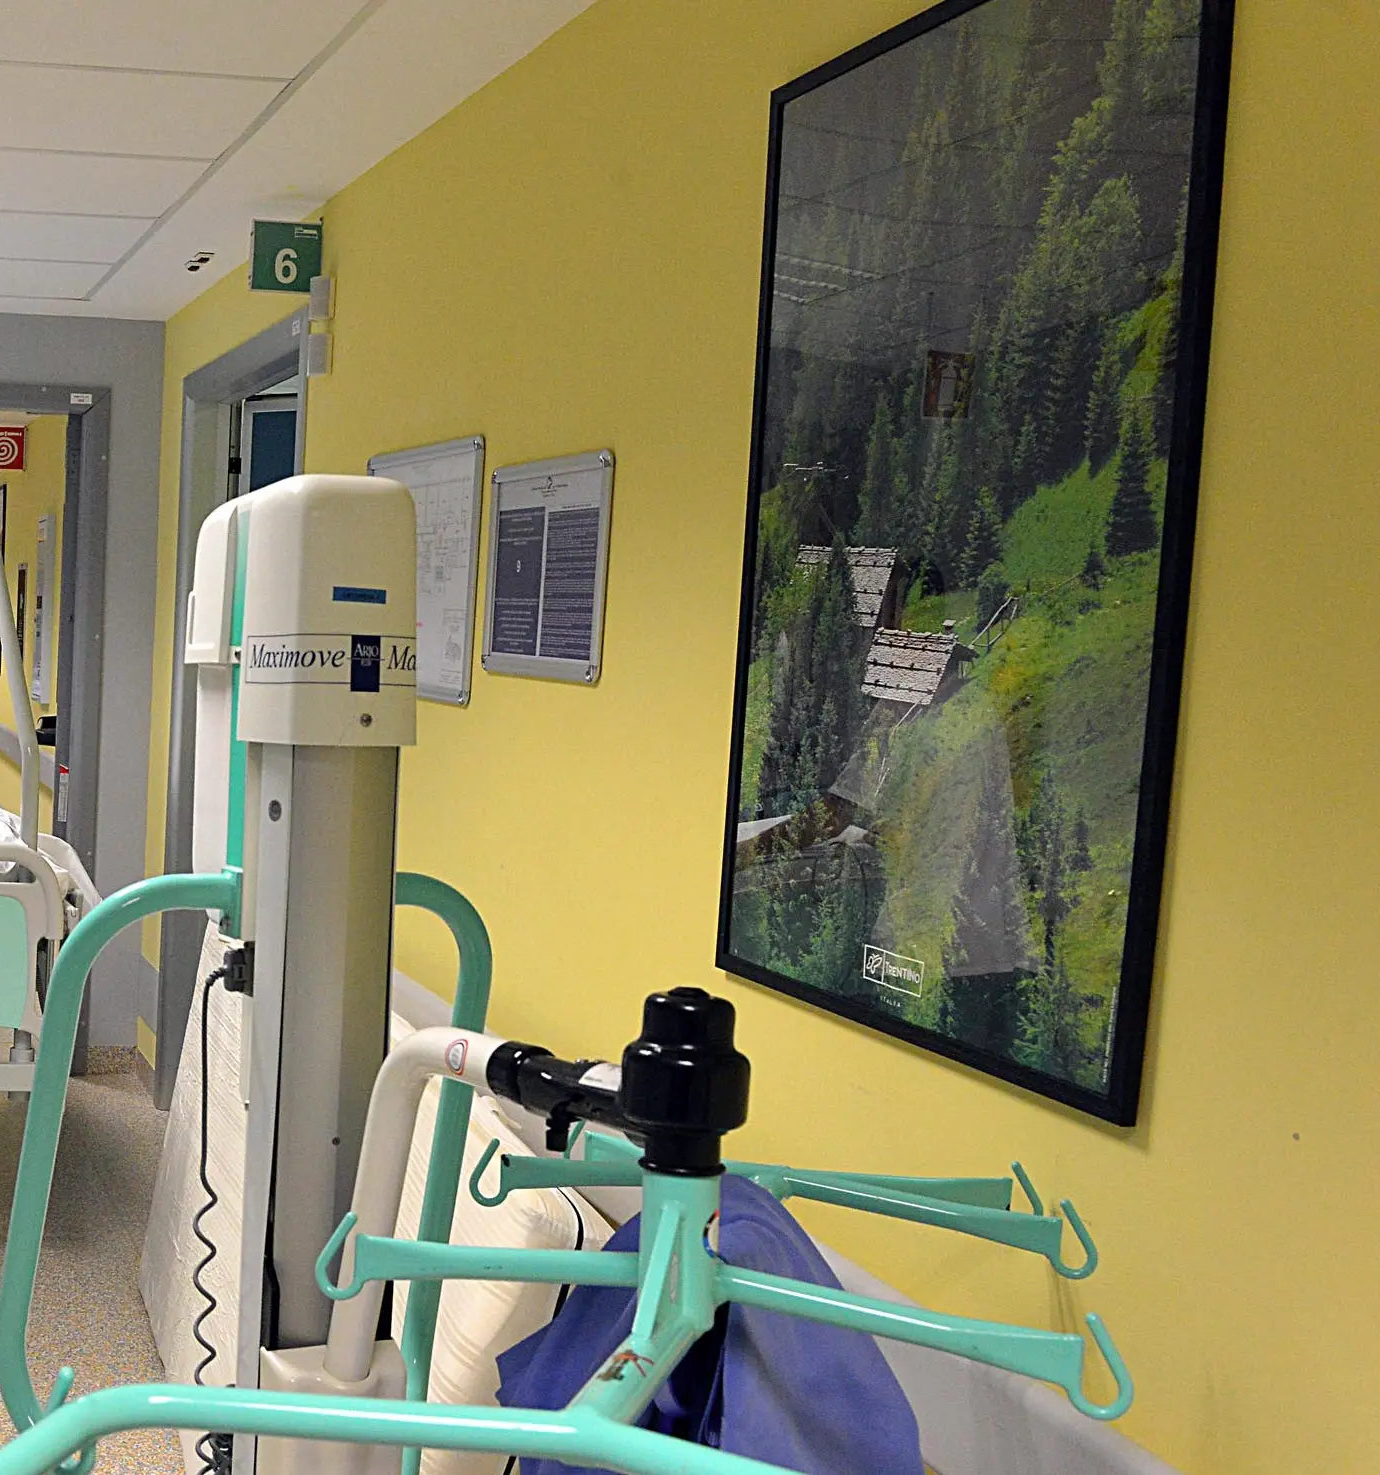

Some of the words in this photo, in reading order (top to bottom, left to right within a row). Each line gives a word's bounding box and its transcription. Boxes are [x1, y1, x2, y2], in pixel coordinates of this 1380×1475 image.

[275, 248, 298, 284] 6
[249, 643, 346, 669] Maximove
[353, 642, 379, 658] ARJO
[885, 961, 921, 984] TRENTINO
[880, 995, 901, 1008] ITALIA
